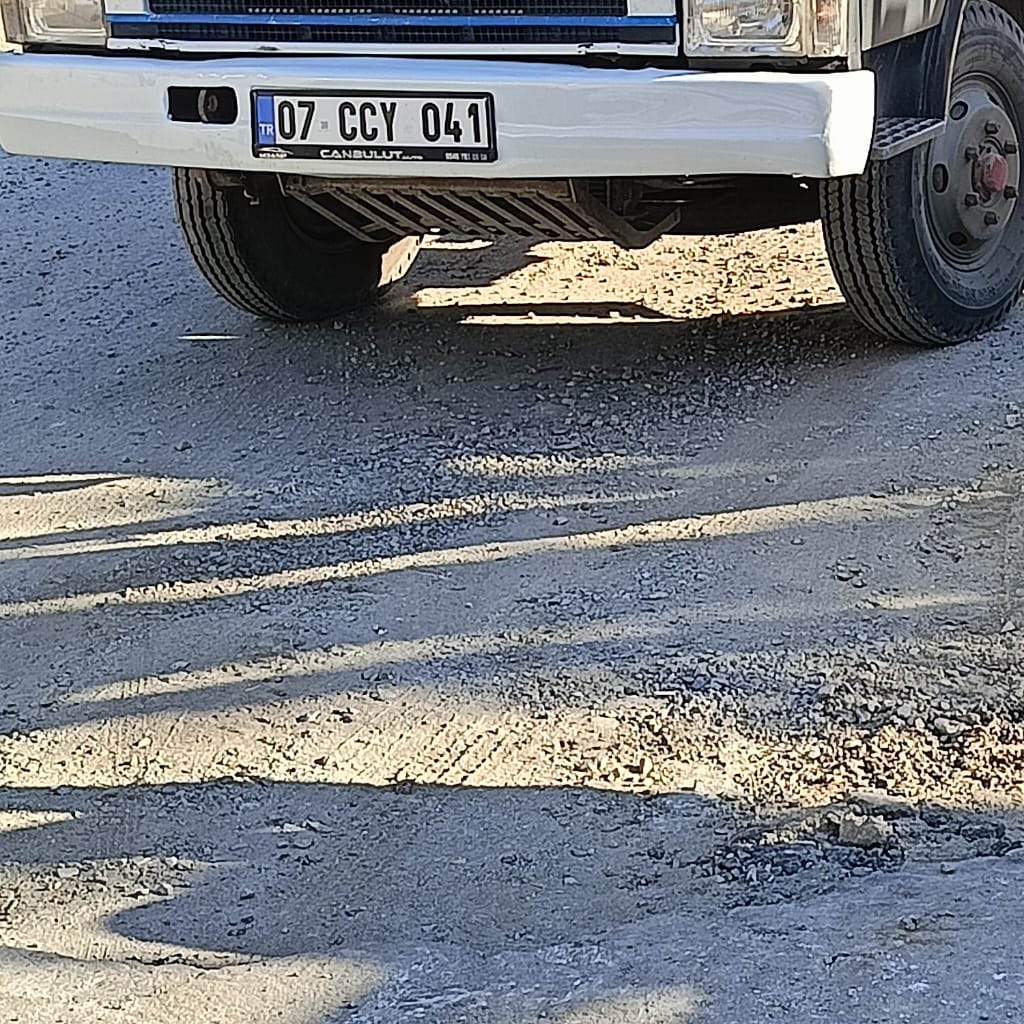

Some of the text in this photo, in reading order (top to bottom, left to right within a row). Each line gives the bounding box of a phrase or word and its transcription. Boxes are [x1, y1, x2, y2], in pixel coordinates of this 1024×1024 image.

[277, 100, 482, 143] 07 CCY 041
[259, 123, 274, 136] TR
[320, 149, 403, 160] CANBULUT
